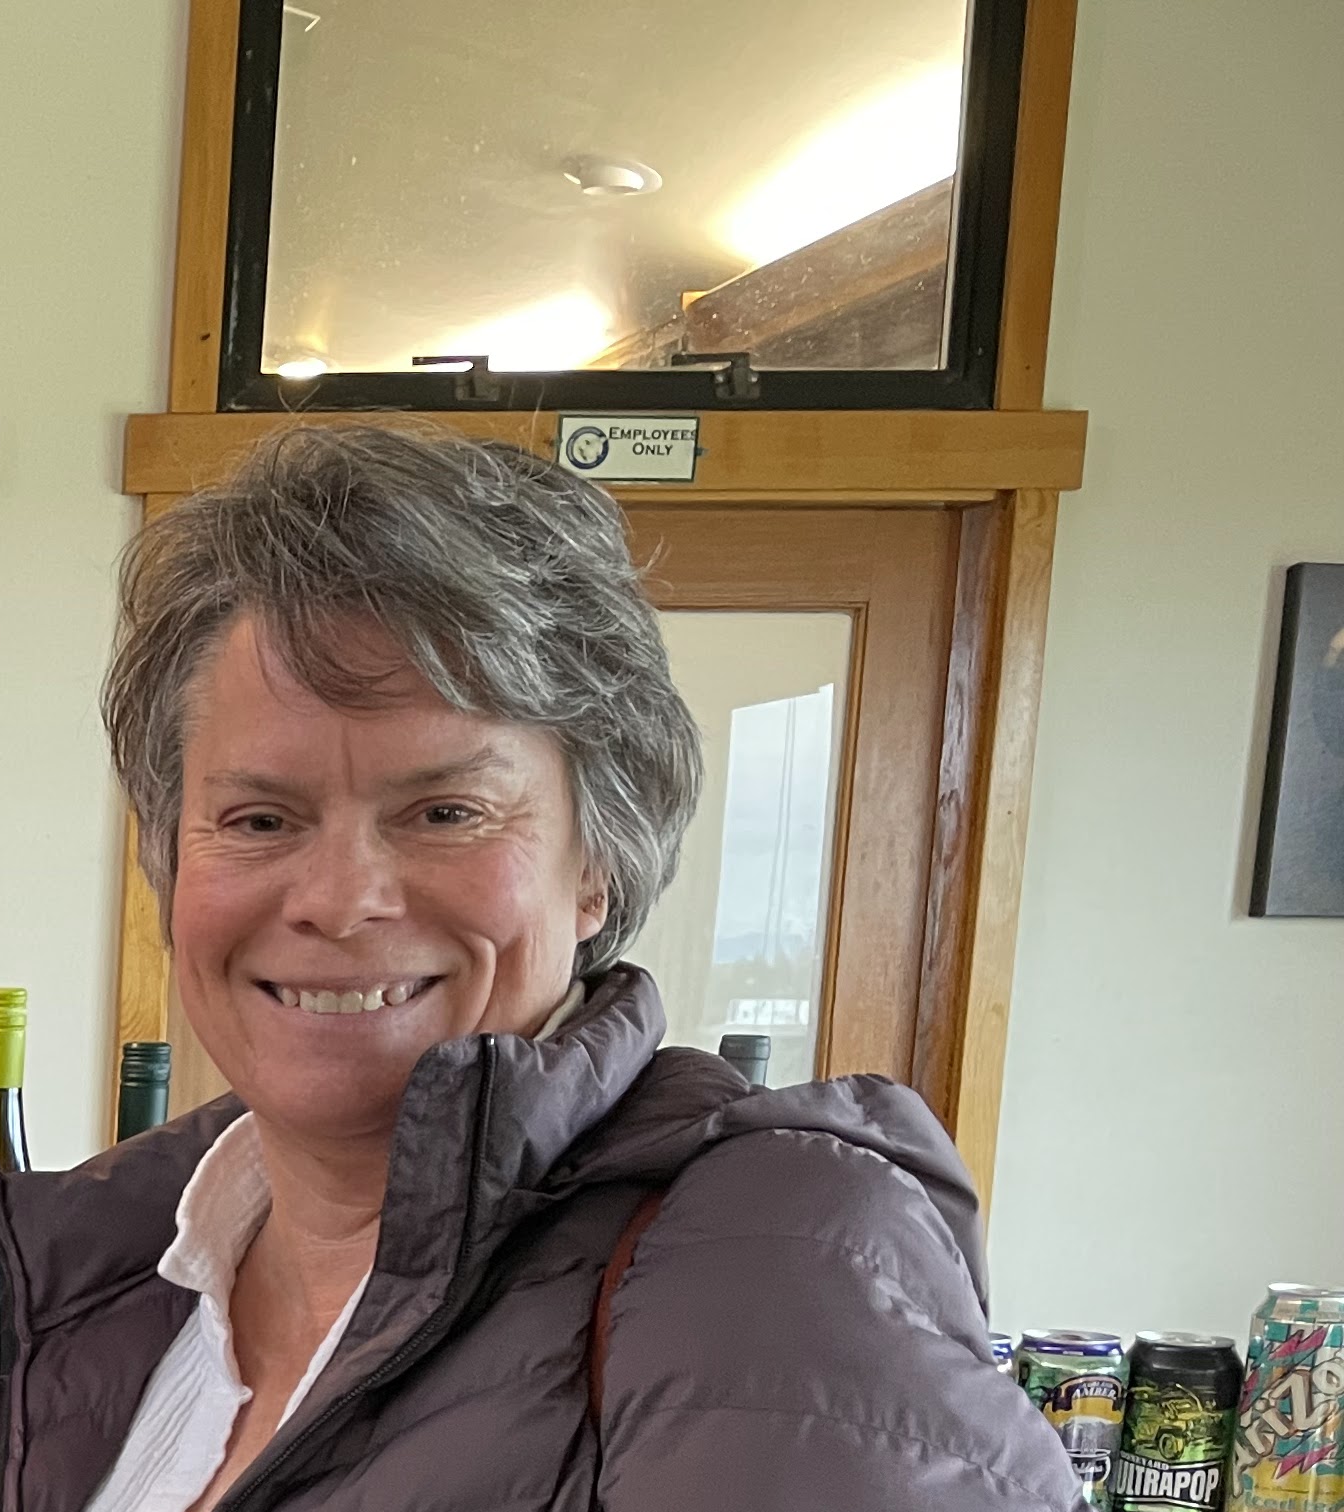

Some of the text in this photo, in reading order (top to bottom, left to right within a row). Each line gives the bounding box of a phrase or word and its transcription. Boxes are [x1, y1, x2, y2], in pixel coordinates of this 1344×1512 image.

[609, 427, 698, 440] EMPLOYEES
[632, 442, 673, 456] ONLY
[1116, 1458, 1219, 1503] ULTRAPOP
